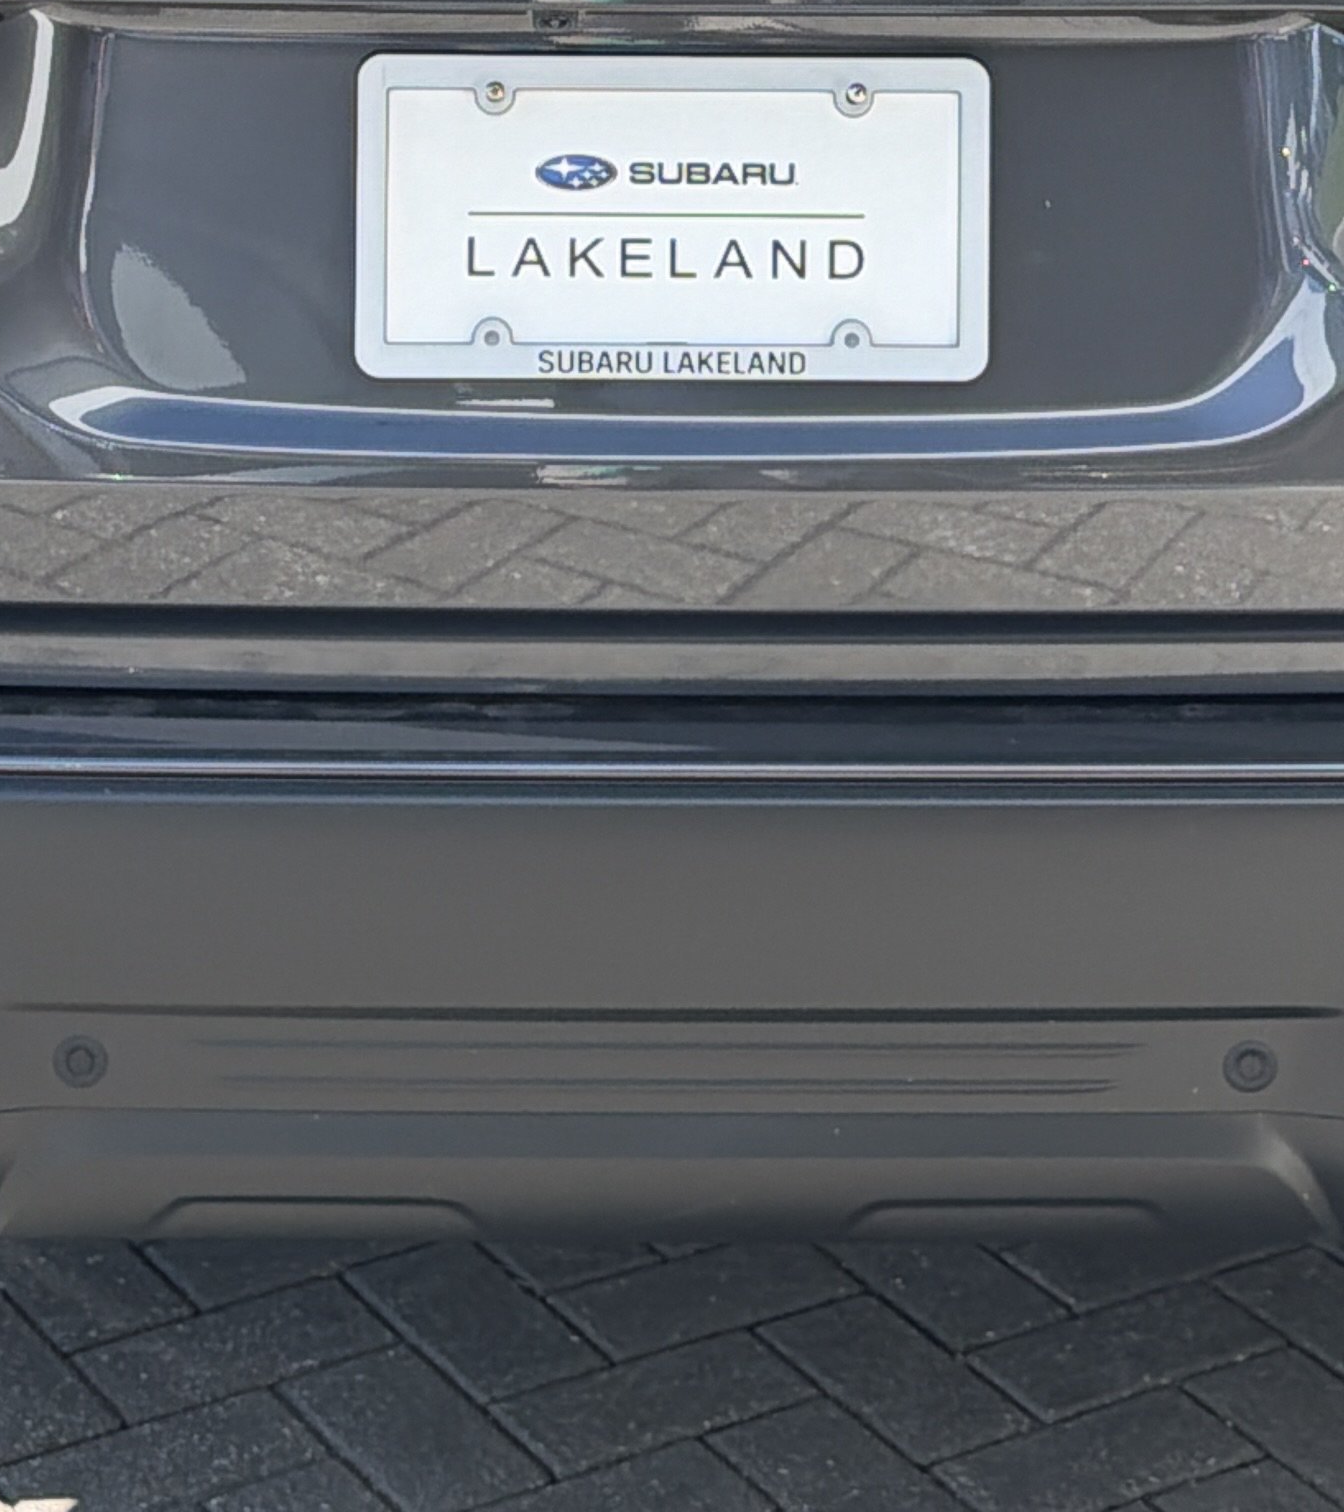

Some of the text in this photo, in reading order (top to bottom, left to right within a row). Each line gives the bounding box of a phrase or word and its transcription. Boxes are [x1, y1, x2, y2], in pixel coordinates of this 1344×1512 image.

[628, 161, 797, 186] SUBARU
[467, 237, 865, 280] LAKELAND
[538, 350, 807, 376] SUBARU LAKELAND
